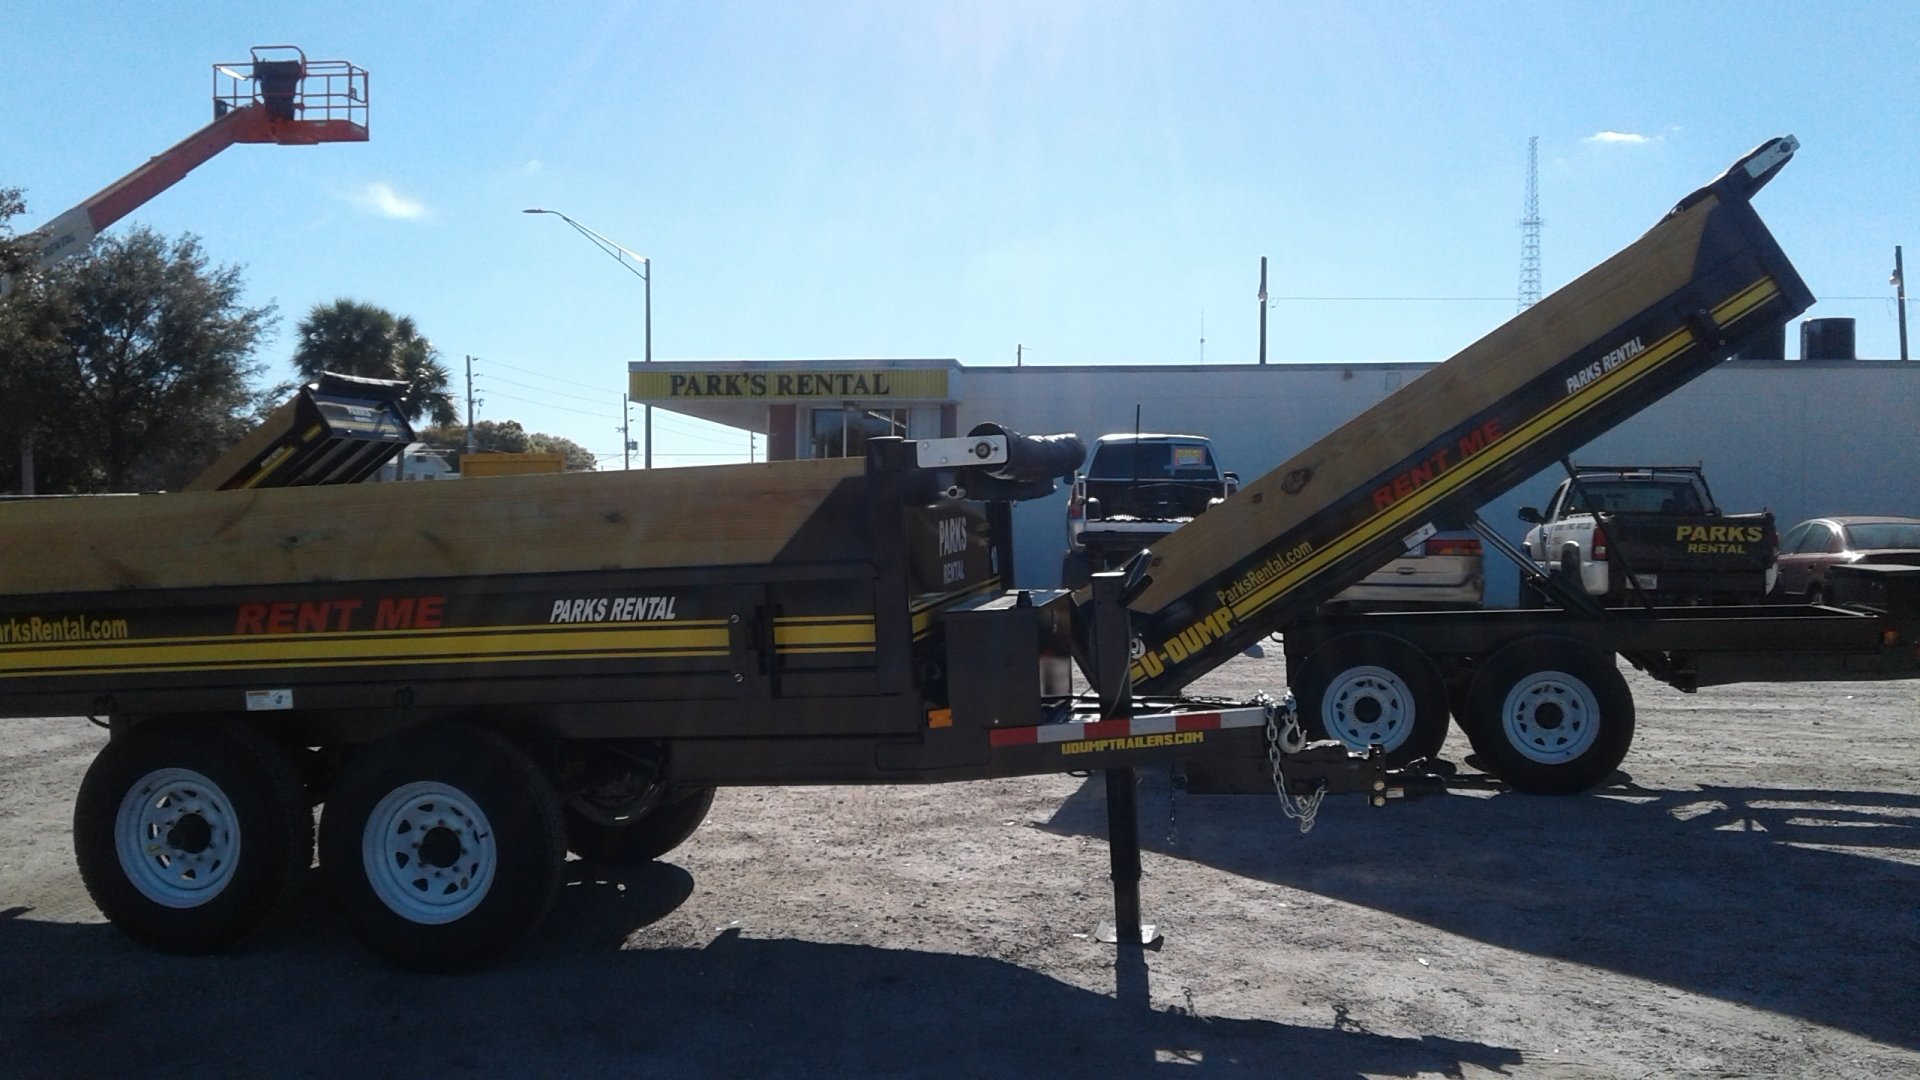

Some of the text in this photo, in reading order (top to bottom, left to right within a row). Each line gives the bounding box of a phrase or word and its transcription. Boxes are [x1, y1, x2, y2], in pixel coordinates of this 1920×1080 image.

[1565, 336, 1645, 393] PARKS RENTAL
[670, 373, 890, 396] PARK'S RENTAL
[1372, 421, 1501, 509] RENT ME
[938, 516, 967, 557] PARKS
[1676, 526, 1763, 542] PARKS
[1687, 543, 1746, 554] RENTAL
[943, 560, 965, 585] RENTAL
[1216, 541, 1313, 606] ParksRental.com
[236, 597, 443, 633] RENT ME
[550, 596, 676, 623] PARKS RENTAL
[1140, 606, 1233, 678] U-DUMP
[1061, 731, 1204, 755] UDUMPTRAILERS.COM
